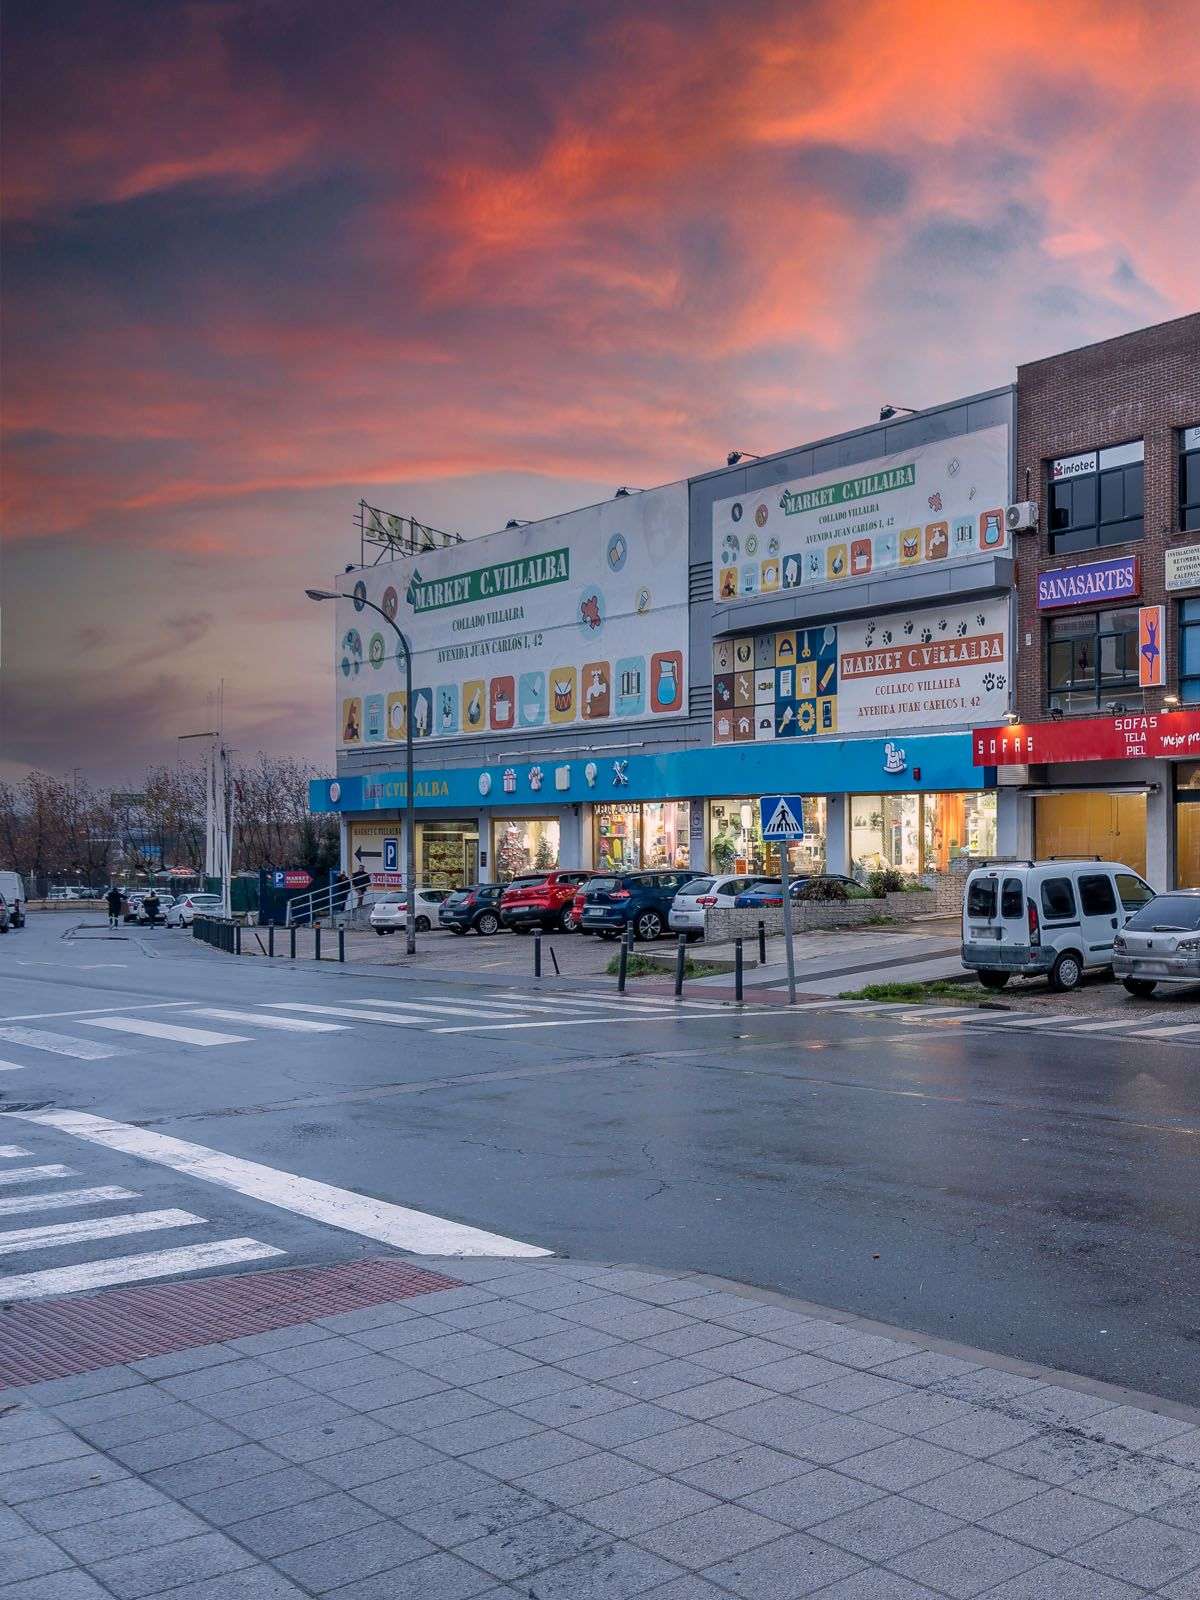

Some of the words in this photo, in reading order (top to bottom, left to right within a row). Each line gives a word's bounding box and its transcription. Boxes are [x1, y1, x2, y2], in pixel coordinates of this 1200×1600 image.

[1063, 460, 1095, 475] infotec
[786, 488, 834, 513] MARKET
[414, 575, 472, 609] MARKET
[479, 552, 568, 595] C.VILLALBA
[1039, 566, 1134, 600] SANASARTES
[452, 613, 485, 632] COLLADO
[487, 605, 525, 624] VILLALBA
[842, 652, 902, 675] MARKET
[907, 638, 1002, 667] C.VILLALBA
[970, 696, 981, 707] 42
[1114, 716, 1157, 731] SOFAS
[978, 736, 1033, 755] SOFAS
[1124, 731, 1147, 743] TELA
[1126, 745, 1146, 755] PIEL
[387, 845, 395, 865] P
[276, 872, 284, 883] P
